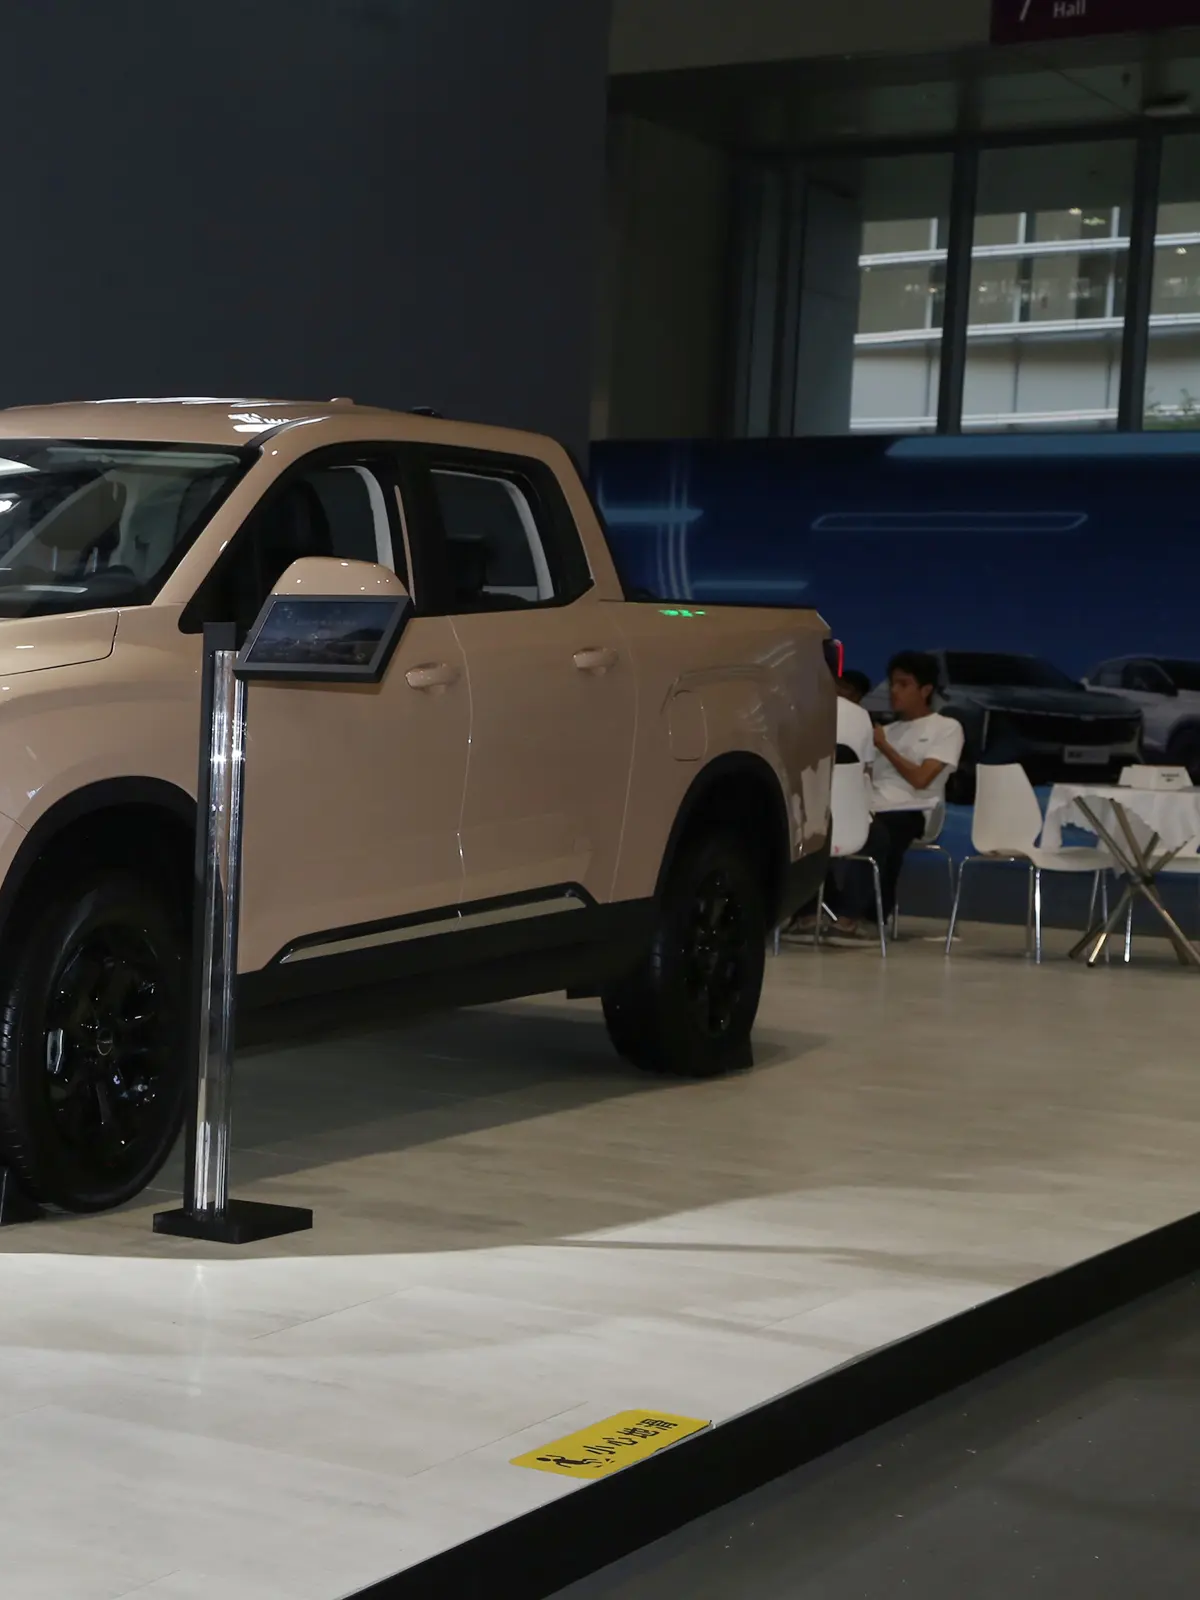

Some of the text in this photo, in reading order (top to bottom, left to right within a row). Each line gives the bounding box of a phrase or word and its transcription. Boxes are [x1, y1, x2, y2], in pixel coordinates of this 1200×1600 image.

[1053, 0, 1086, 18] Hall
[583, 1418, 678, 1455] 小心地滑
